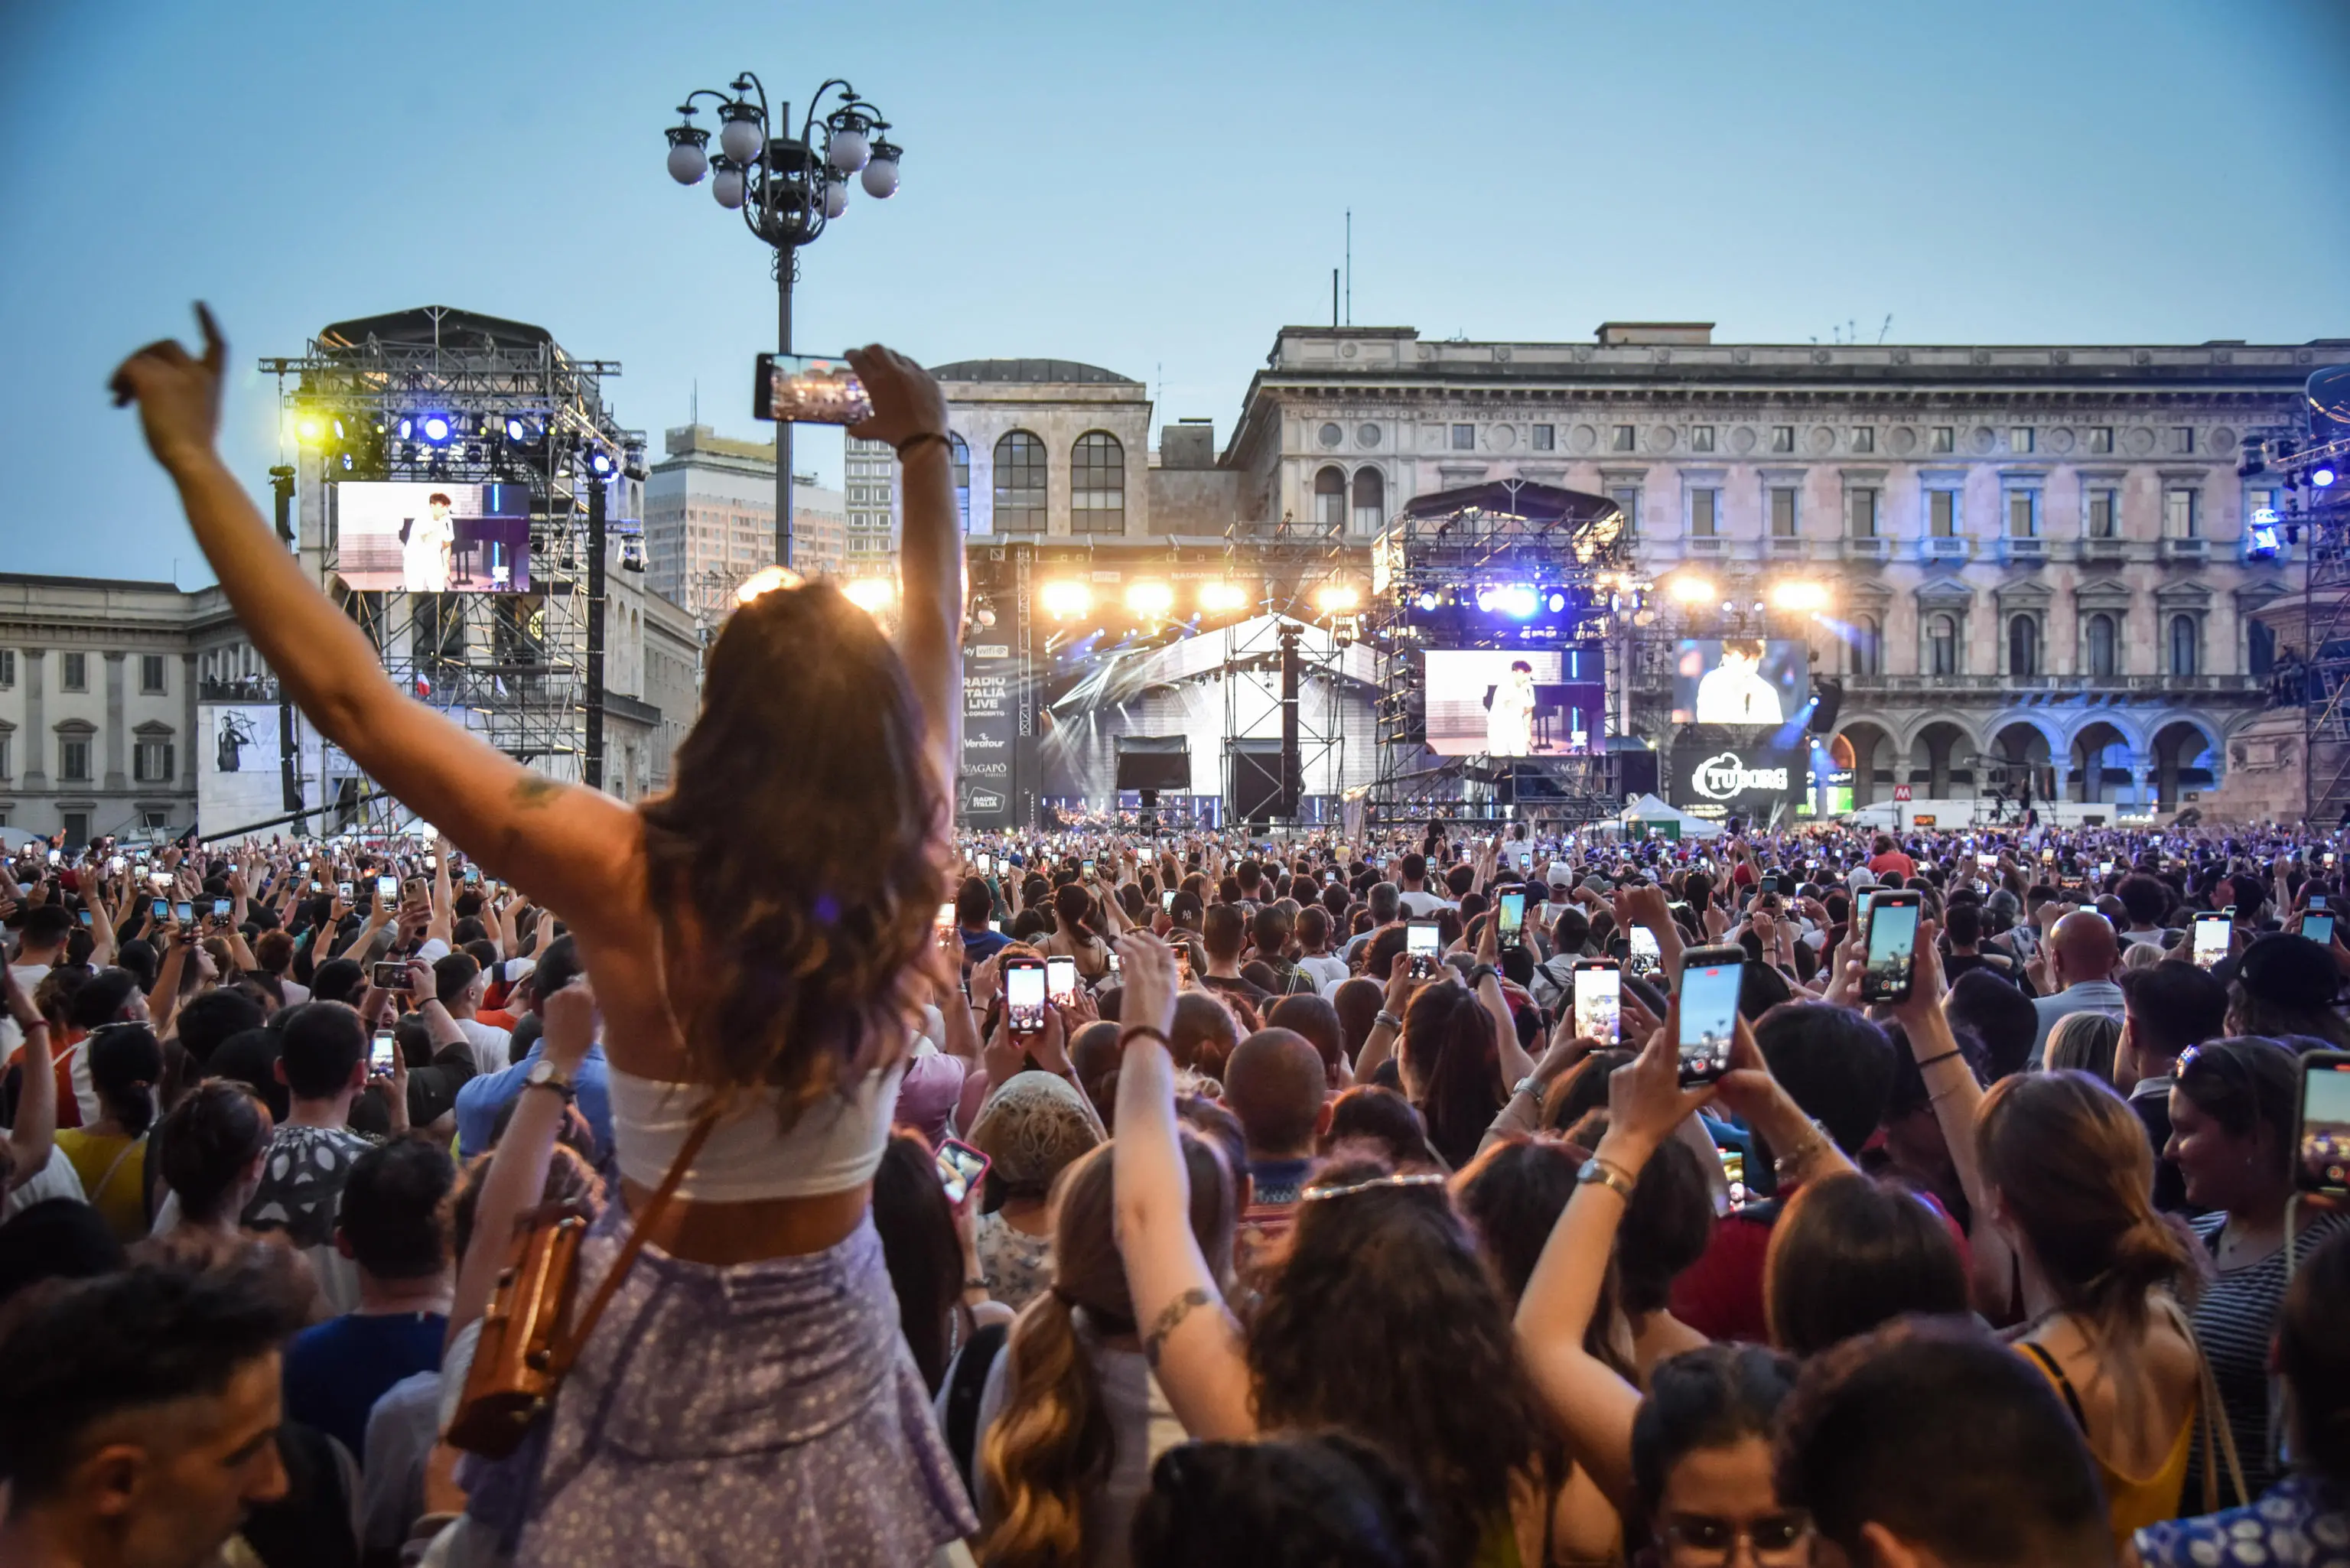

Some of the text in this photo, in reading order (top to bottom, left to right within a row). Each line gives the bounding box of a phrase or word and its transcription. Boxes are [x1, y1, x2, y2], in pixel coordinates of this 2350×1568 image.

[964, 646, 975, 656] ky
[963, 677, 1006, 687] RADIO
[965, 688, 1006, 698] TALIA
[969, 699, 998, 708] LIVE
[965, 739, 1005, 748] Veratour
[1707, 768, 1789, 789] TUBORG
[1896, 788, 1910, 799] M
